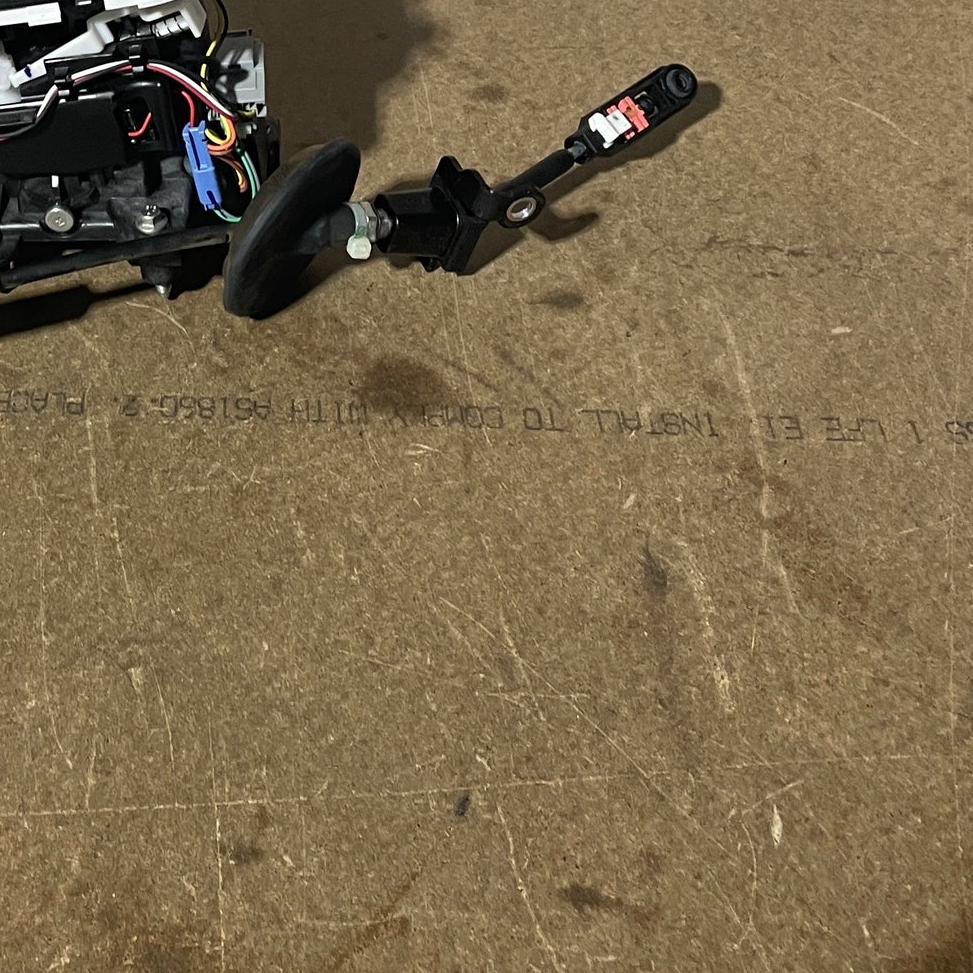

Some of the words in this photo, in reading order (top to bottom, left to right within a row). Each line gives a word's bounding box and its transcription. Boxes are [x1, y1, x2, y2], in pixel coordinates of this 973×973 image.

[290, 399, 369, 426] WITH
[389, 402, 504, 429] COMPLY
[523, 406, 570, 432] TO
[579, 408, 719, 438] INSTALL
[820, 417, 887, 443] LFE
